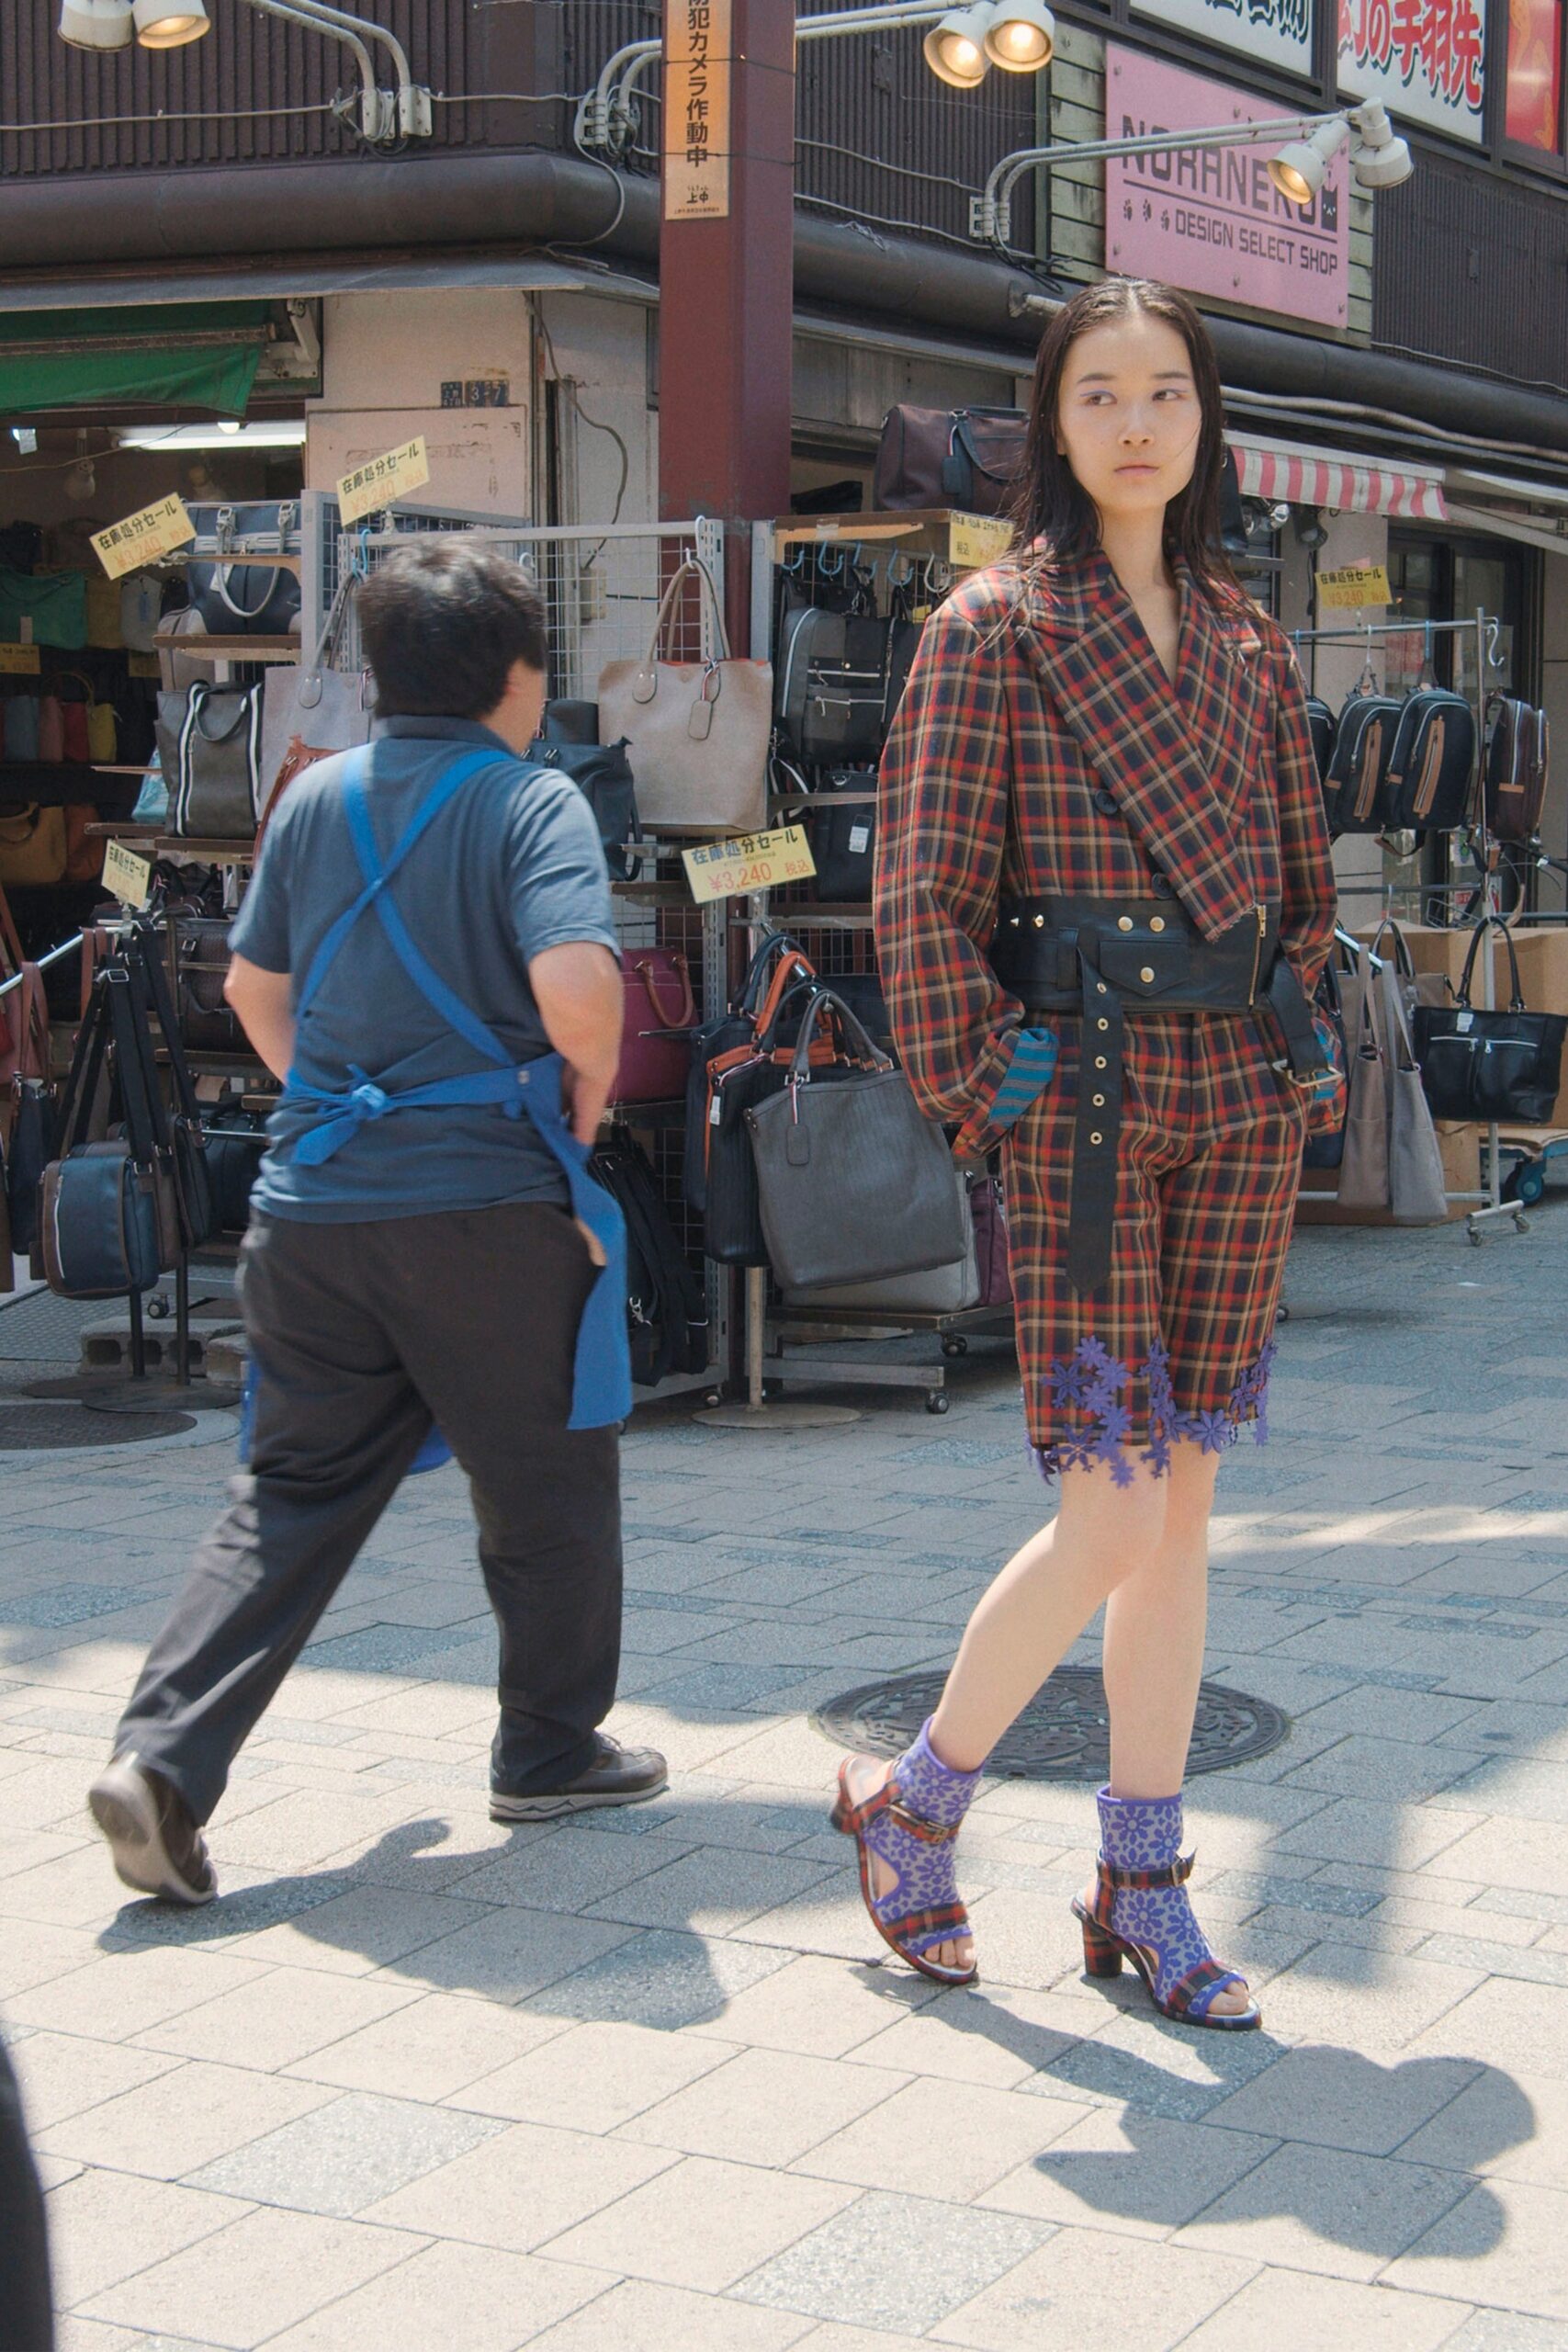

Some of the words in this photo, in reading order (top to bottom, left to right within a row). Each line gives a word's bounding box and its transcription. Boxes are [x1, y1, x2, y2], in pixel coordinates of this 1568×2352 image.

[686, 0, 710, 167] 犯カメラ作動中
[686, 191, 709, 204] 上中
[1175, 209, 1234, 249] DESIGN
[1239, 228, 1295, 265] SELECT
[1300, 245, 1337, 276] SHOP
[341, 442, 419, 495] 在庫処分セール
[97, 501, 177, 550] 在庫処分セール
[691, 828, 798, 865] 在庫処分セール
[707, 862, 772, 892] ¥3,240
